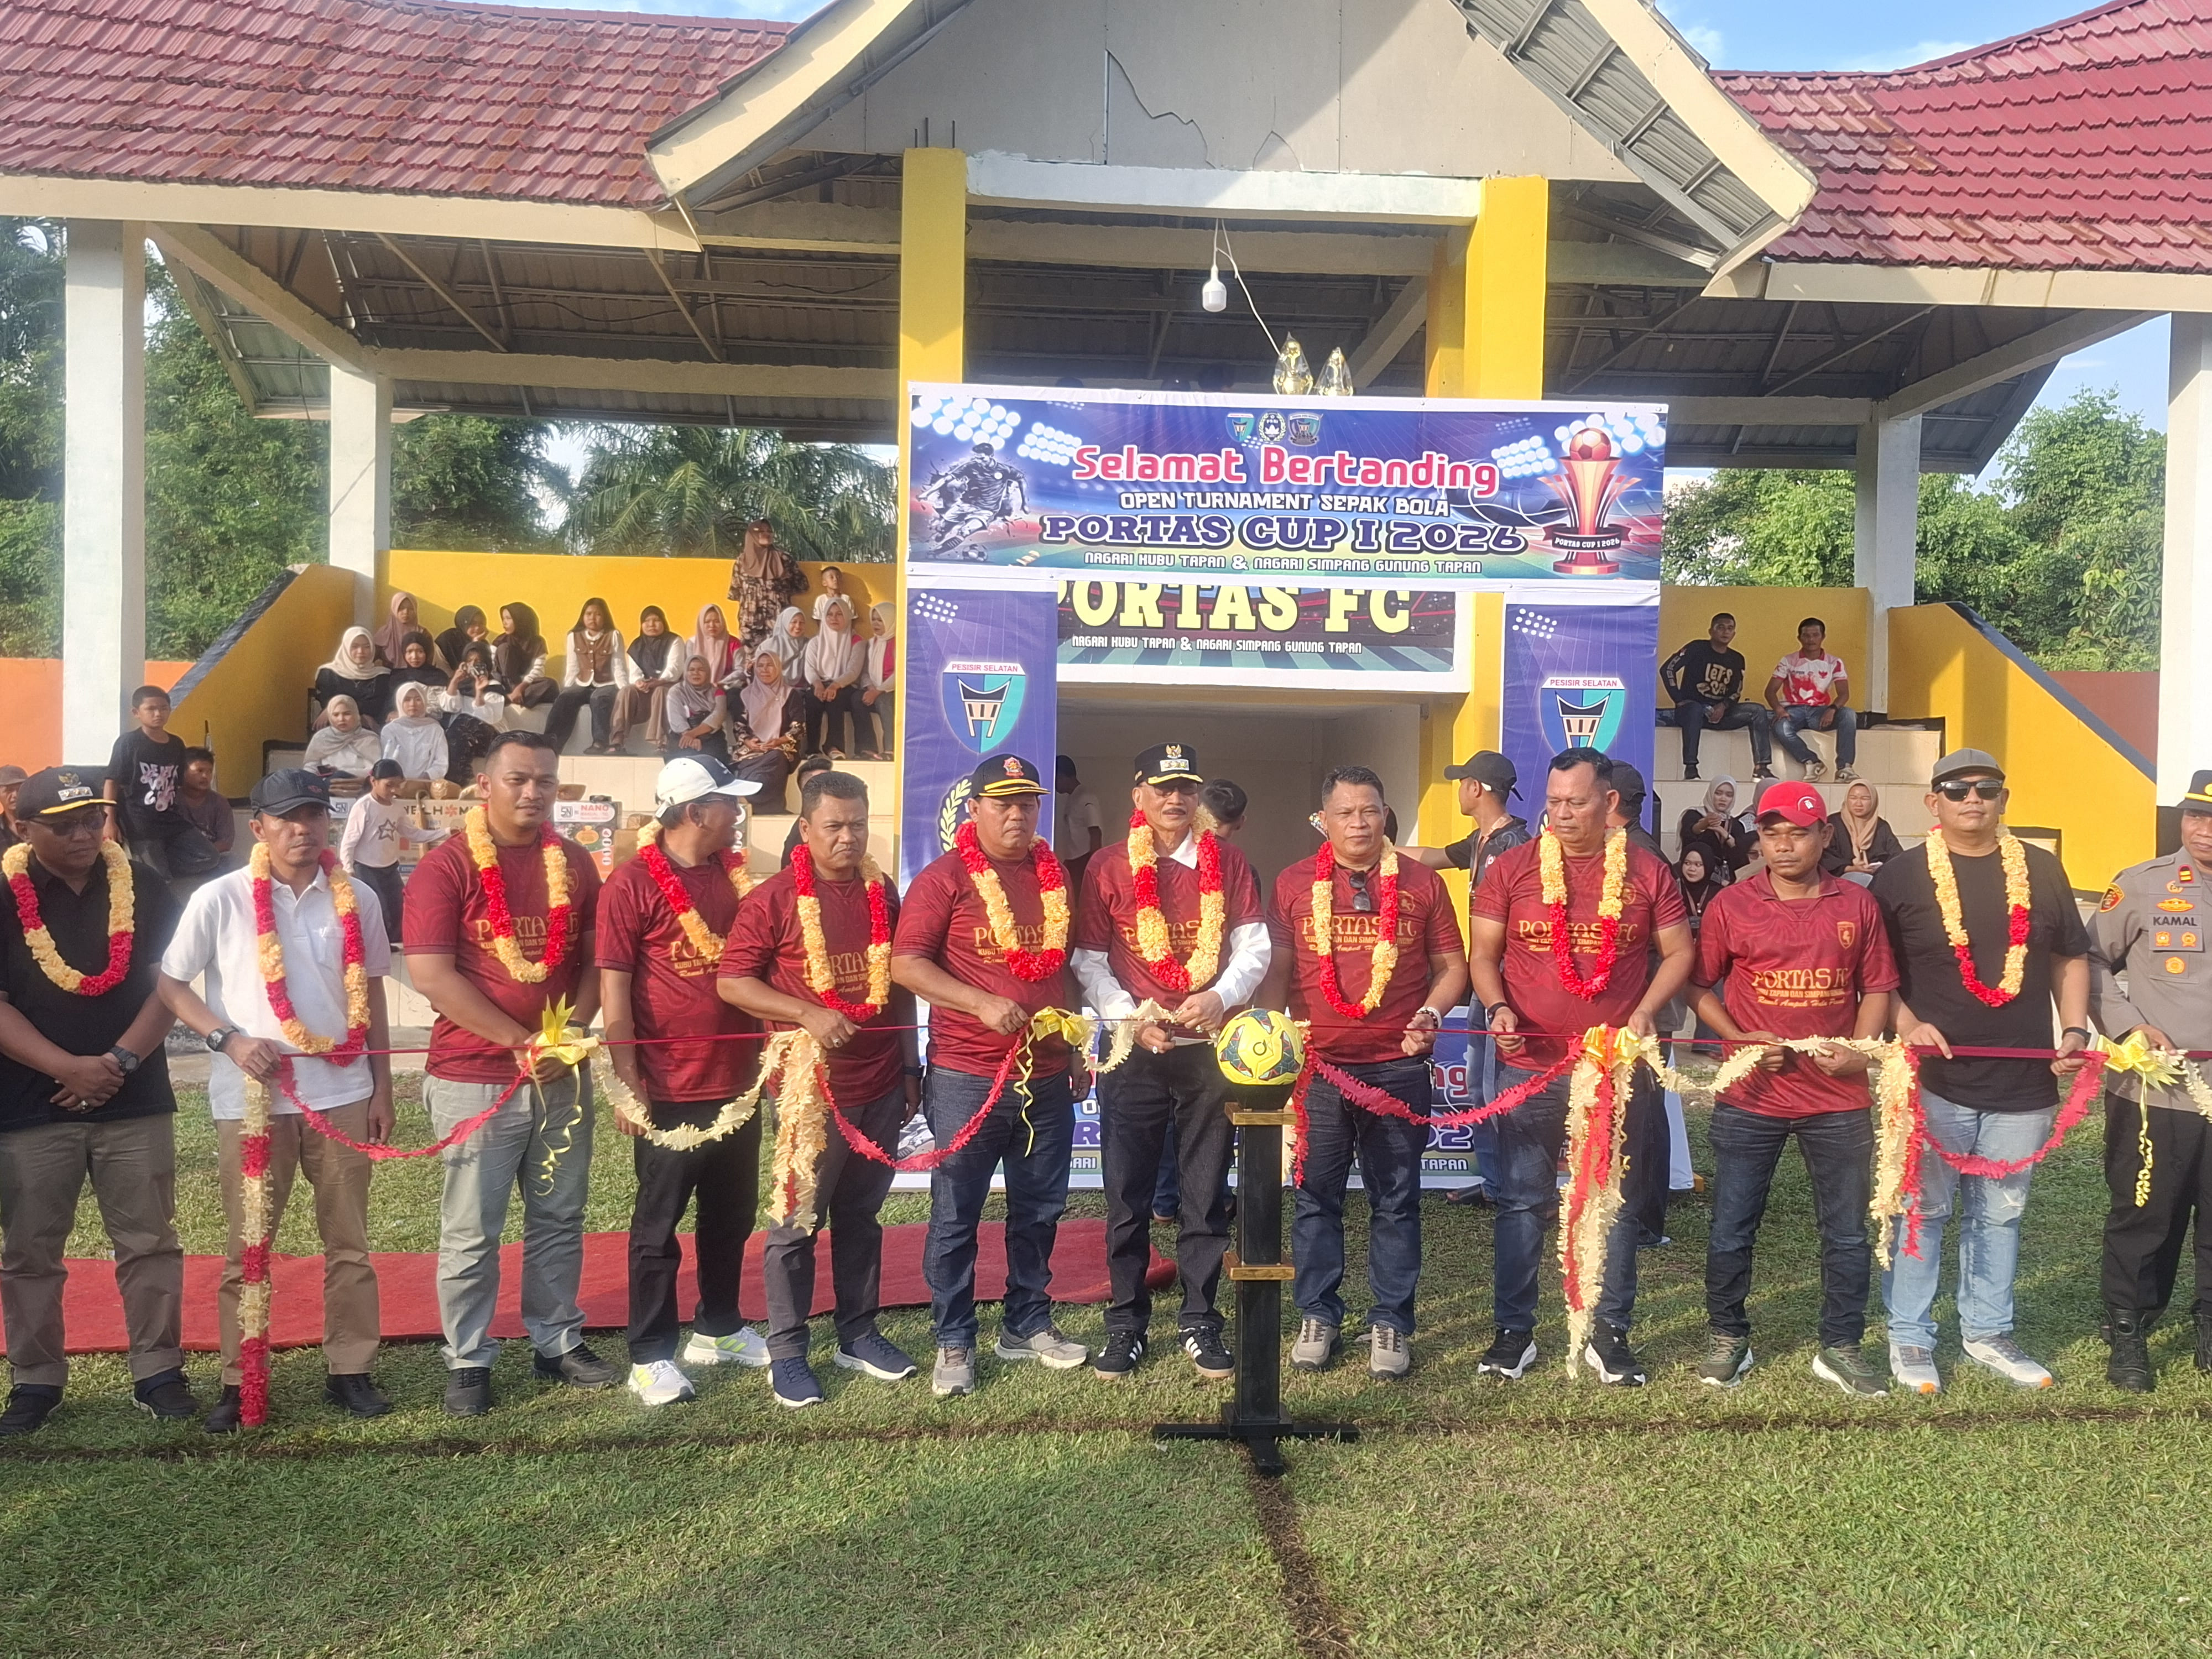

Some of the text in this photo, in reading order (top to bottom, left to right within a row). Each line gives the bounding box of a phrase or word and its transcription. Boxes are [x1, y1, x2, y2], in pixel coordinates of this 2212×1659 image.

[1073, 445, 1498, 497] Selamat Bertanding
[1120, 492, 1450, 517] OPEN TURNAMENT SEPAK BOLA
[1044, 515, 1526, 551] PORTAS CUP I 2026
[1602, 538, 1620, 546] 2026
[1084, 552, 1133, 565] NAGARI
[1181, 555, 1225, 568] TAPAN
[1232, 555, 1249, 570] &
[1254, 557, 1303, 570] NAGARI
[1308, 559, 1370, 571] SIMPANG
[1375, 560, 1430, 572] GUNUNG
[1435, 561, 1482, 573] TAPAN
[1058, 581, 1410, 633] ORTAS FC
[1072, 635, 1108, 648] NAGARI
[1142, 637, 1176, 649] TAPAN
[1180, 637, 1193, 651] &
[1196, 639, 1232, 650] NAGARI
[1235, 639, 1281, 652] SIMPANG
[1285, 640, 1324, 653] GUNUNG
[1328, 641, 1363, 654] TAPAN
[2153, 916, 2198, 927] KAMAL
[1751, 968, 1832, 989] PORTAS
[1421, 1159, 1468, 1170] TAPAN
